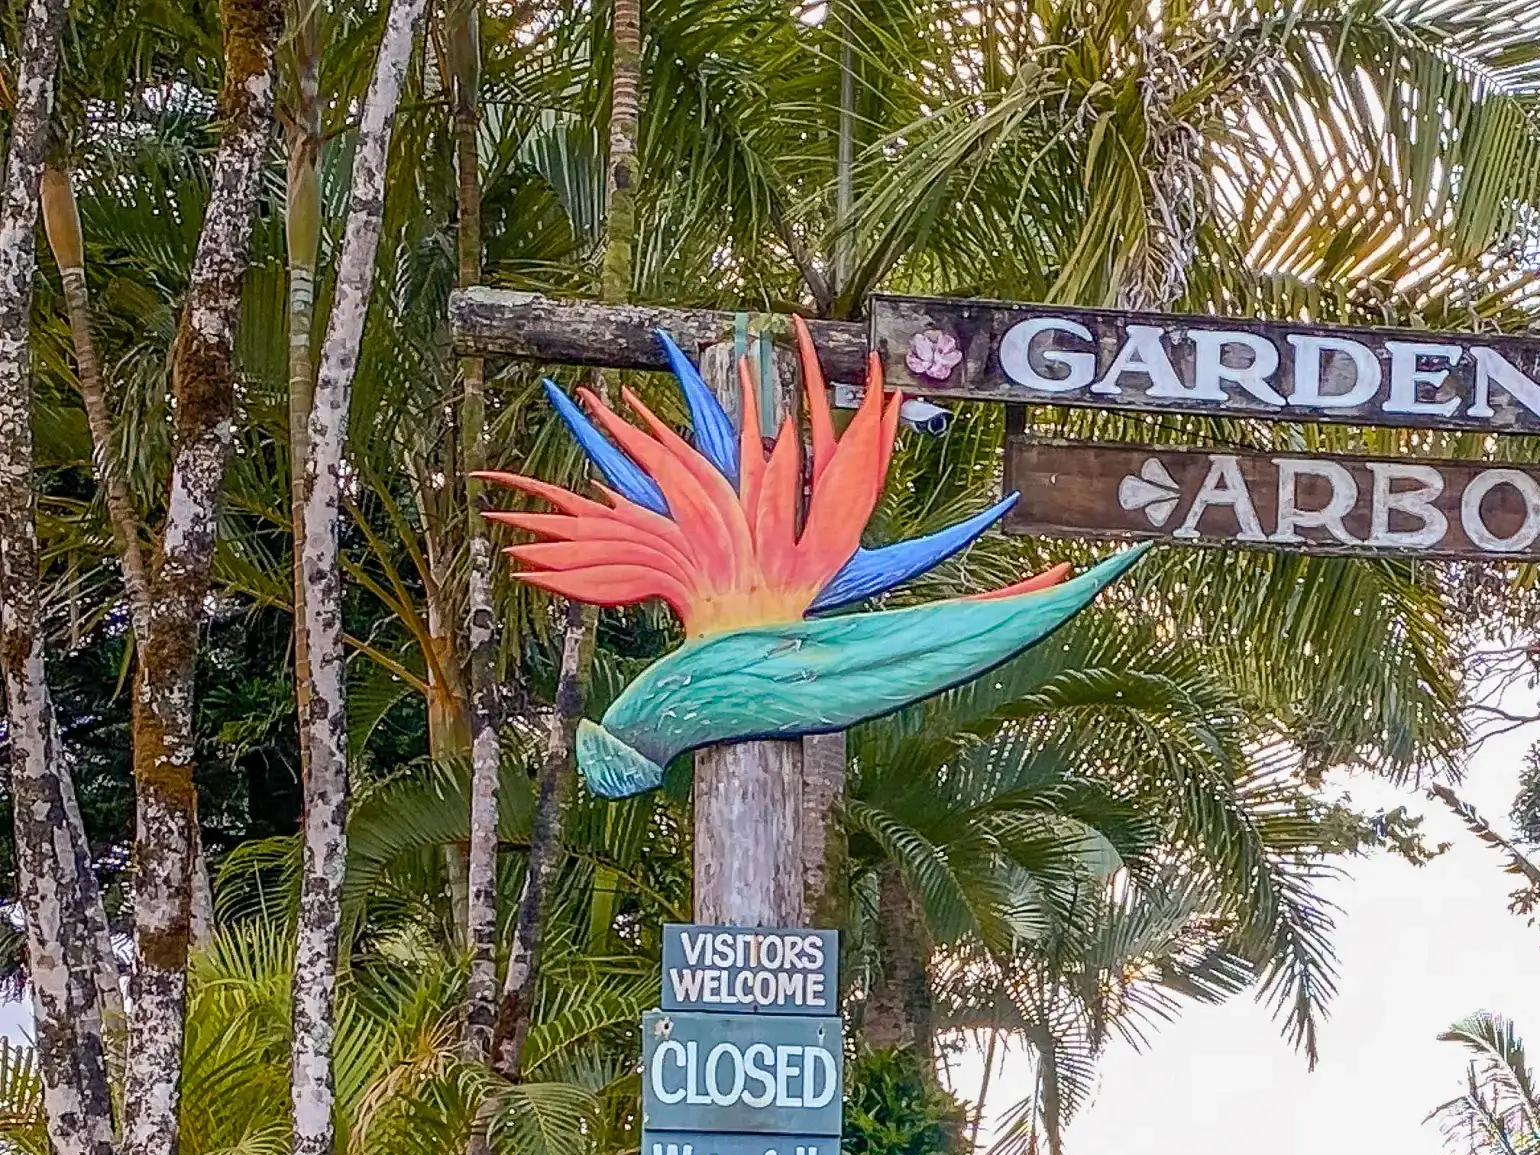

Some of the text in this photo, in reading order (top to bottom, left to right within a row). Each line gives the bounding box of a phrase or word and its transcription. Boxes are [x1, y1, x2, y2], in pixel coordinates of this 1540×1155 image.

[680, 932, 825, 970] VISITORS
[669, 968, 826, 1006] WELCOME
[650, 1040, 838, 1108] CLOSED
